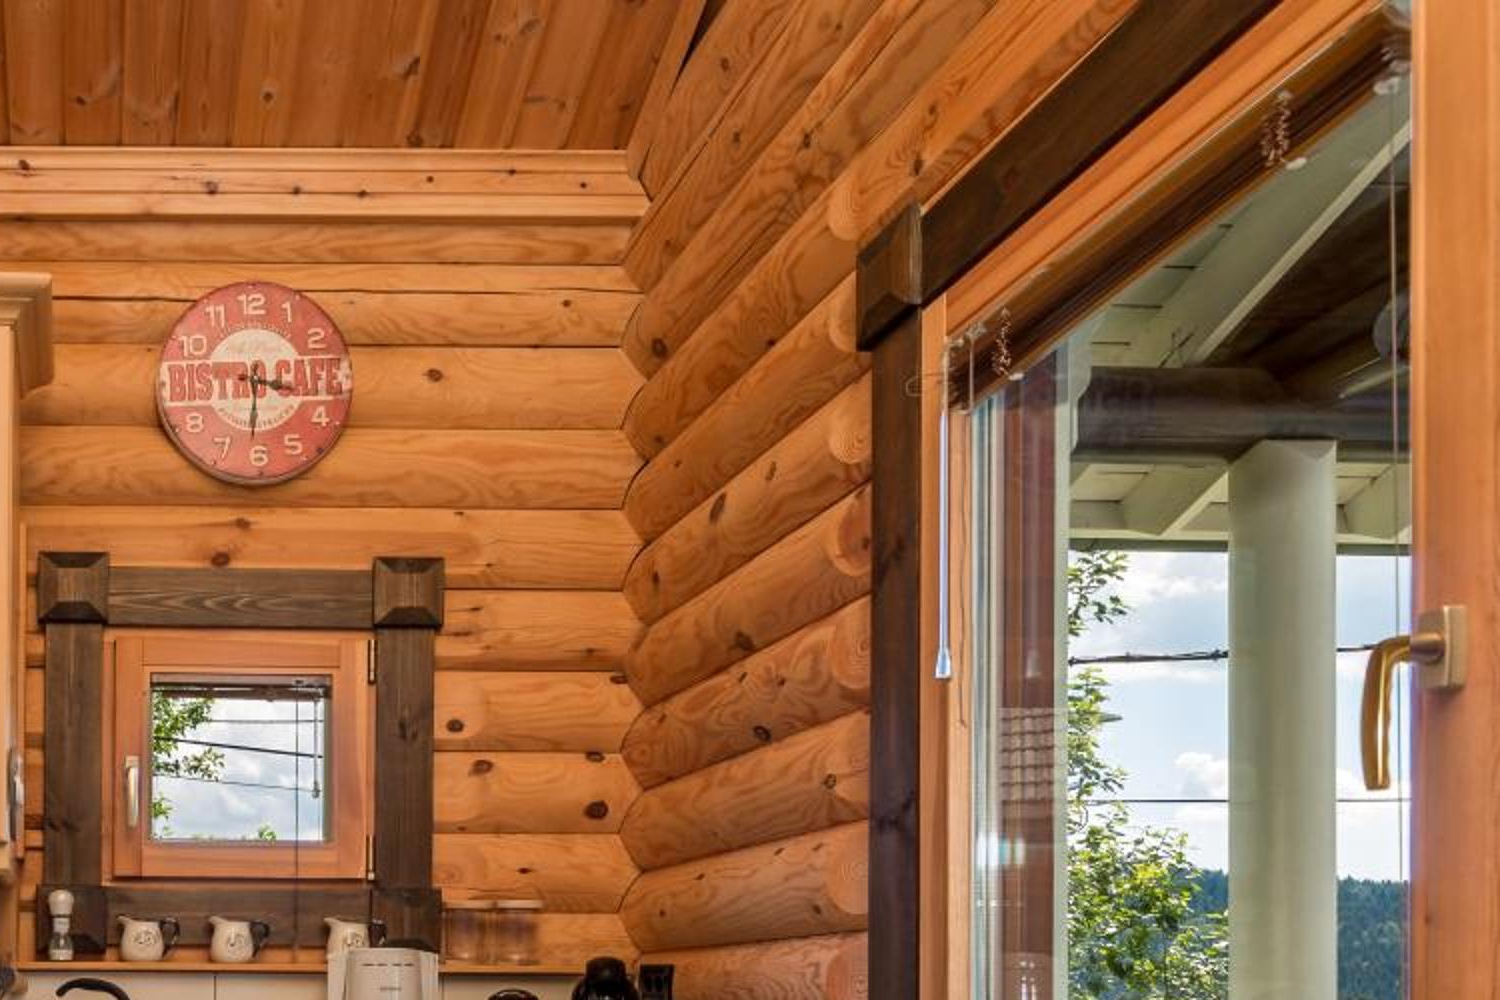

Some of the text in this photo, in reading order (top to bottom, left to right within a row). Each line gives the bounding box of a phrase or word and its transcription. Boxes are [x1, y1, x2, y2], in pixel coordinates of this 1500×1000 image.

[237, 293, 267, 315] 12
[281, 302, 293, 323] 1
[205, 304, 225, 328] 11
[178, 335, 207, 358] 10
[307, 328, 327, 349] 2
[168, 357, 343, 402] BISTRO CAFE
[185, 412, 204, 433] 8
[311, 405, 330, 427] 4
[213, 436, 231, 459] 7
[283, 434, 303, 455] 5
[251, 445, 269, 467] 6
